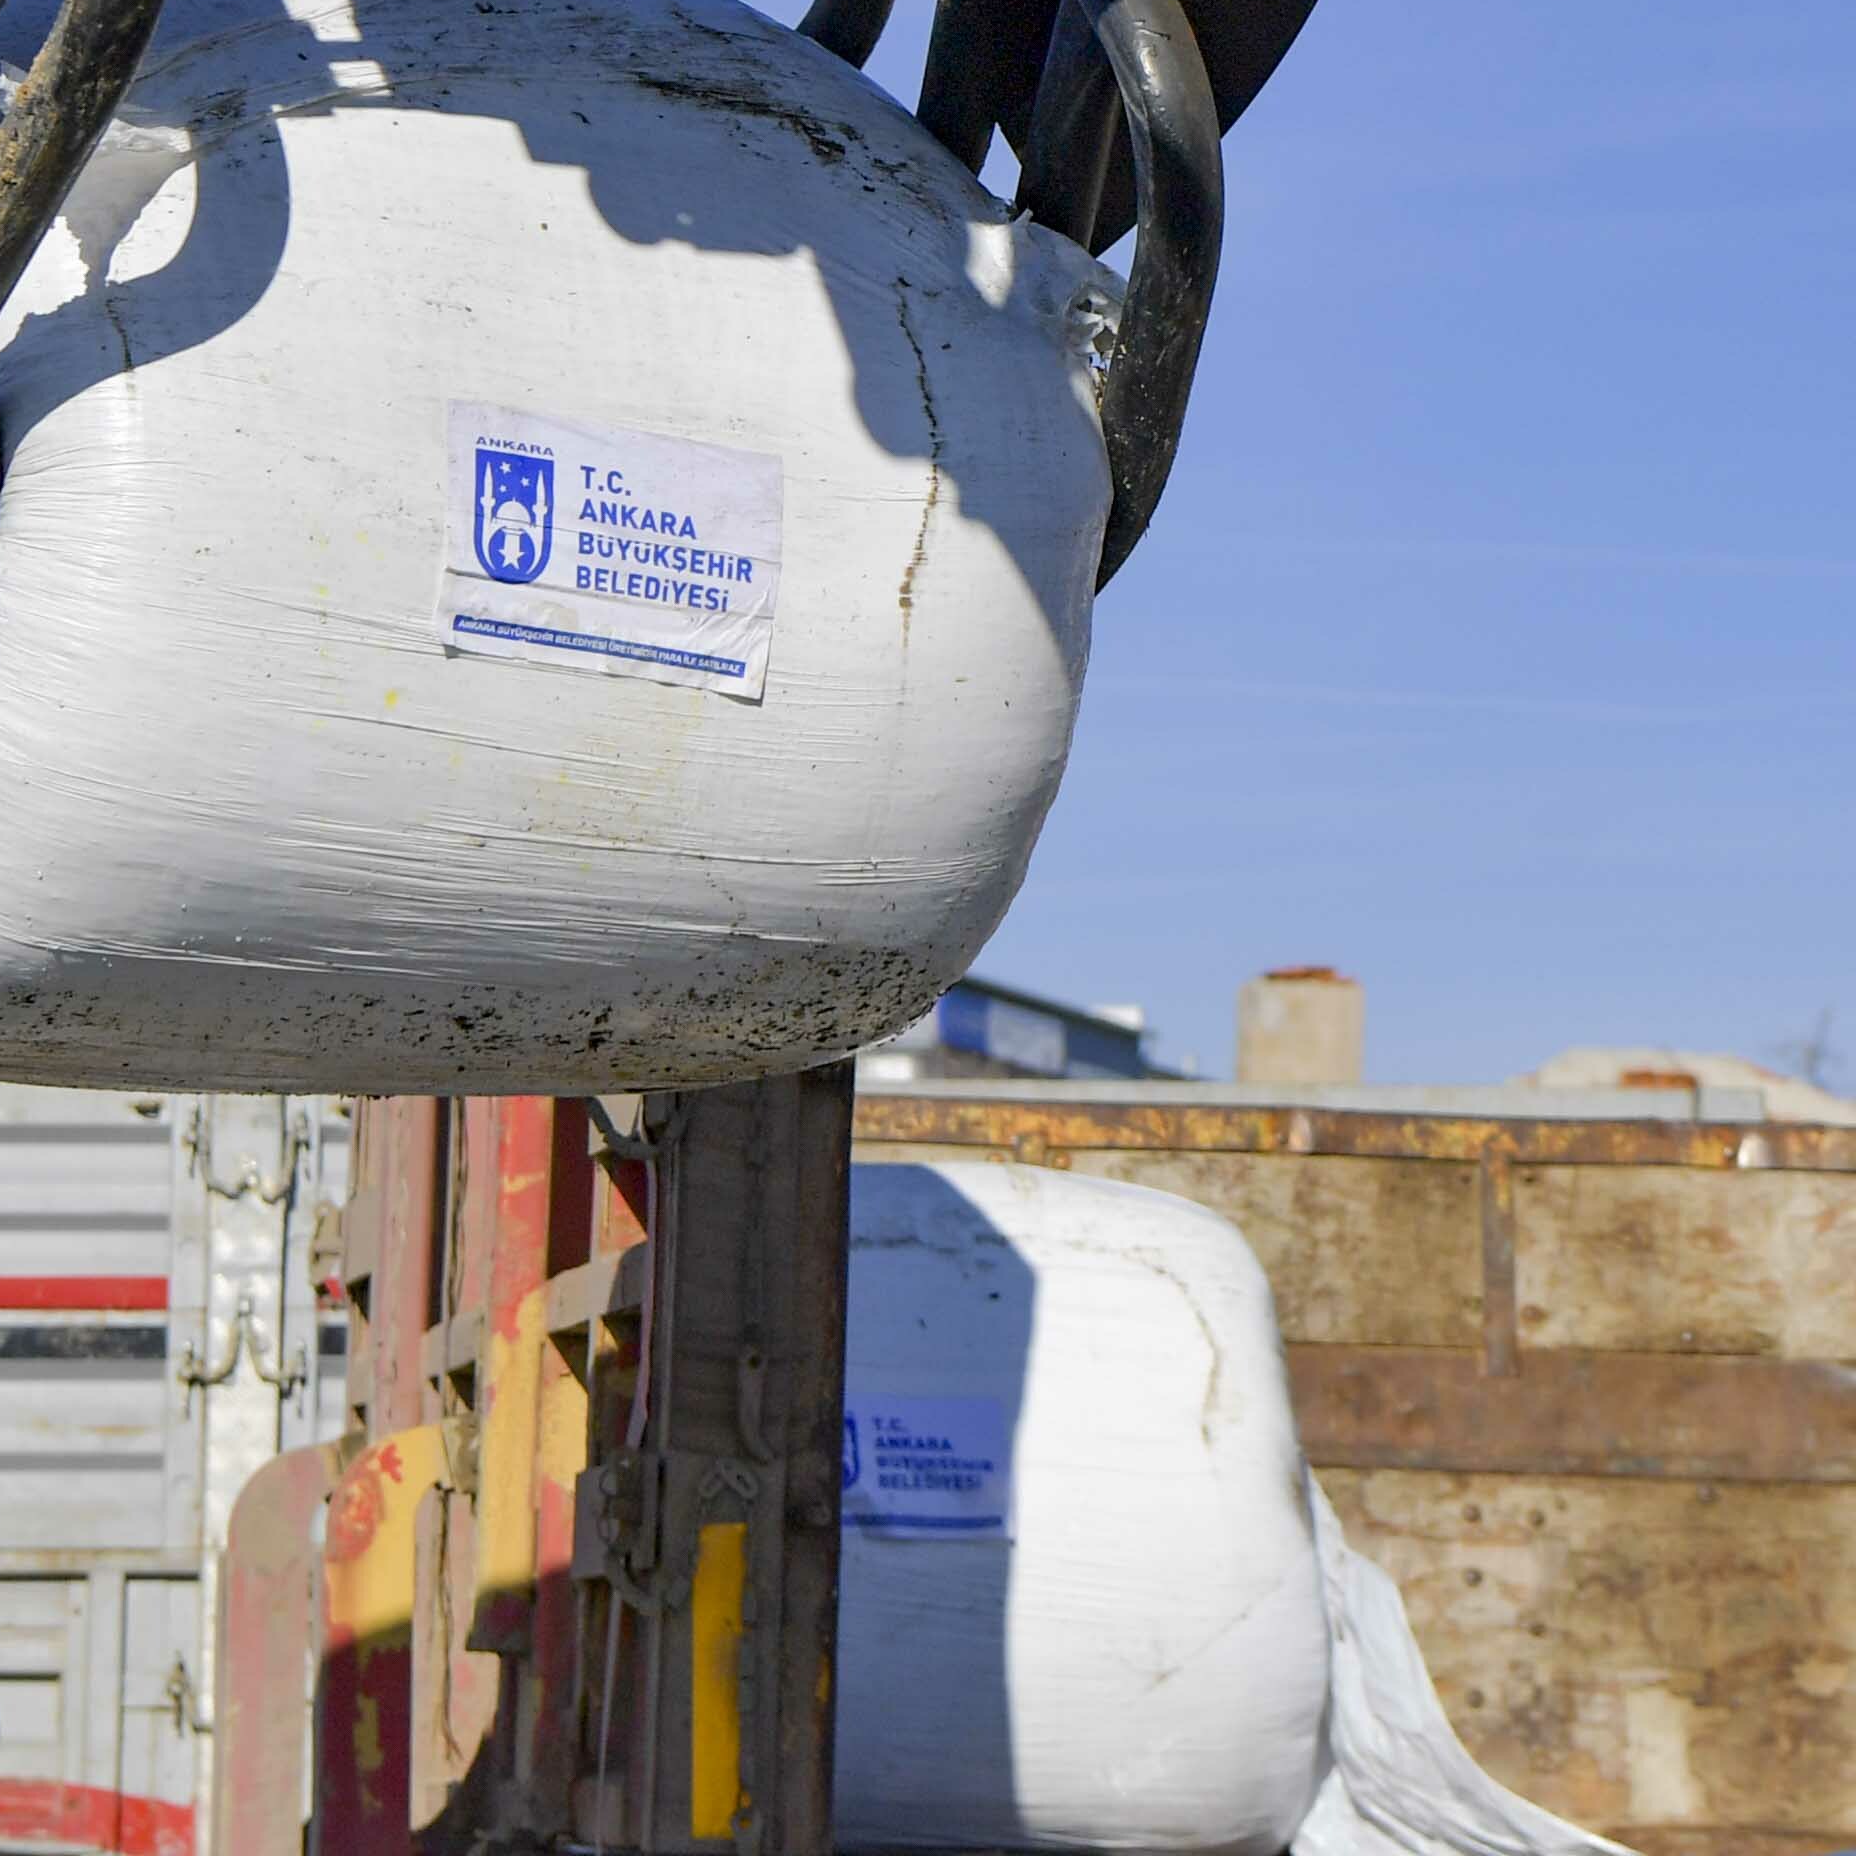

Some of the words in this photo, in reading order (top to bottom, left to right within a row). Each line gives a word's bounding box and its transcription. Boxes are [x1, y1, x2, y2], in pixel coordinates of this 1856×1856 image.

[475, 436, 554, 457] ANKARA
[580, 465, 631, 497] T.C.
[579, 499, 696, 540] ANKARA
[578, 532, 753, 584] BÜYÜKŞEHİR
[576, 565, 728, 613] BELEDİYESİ
